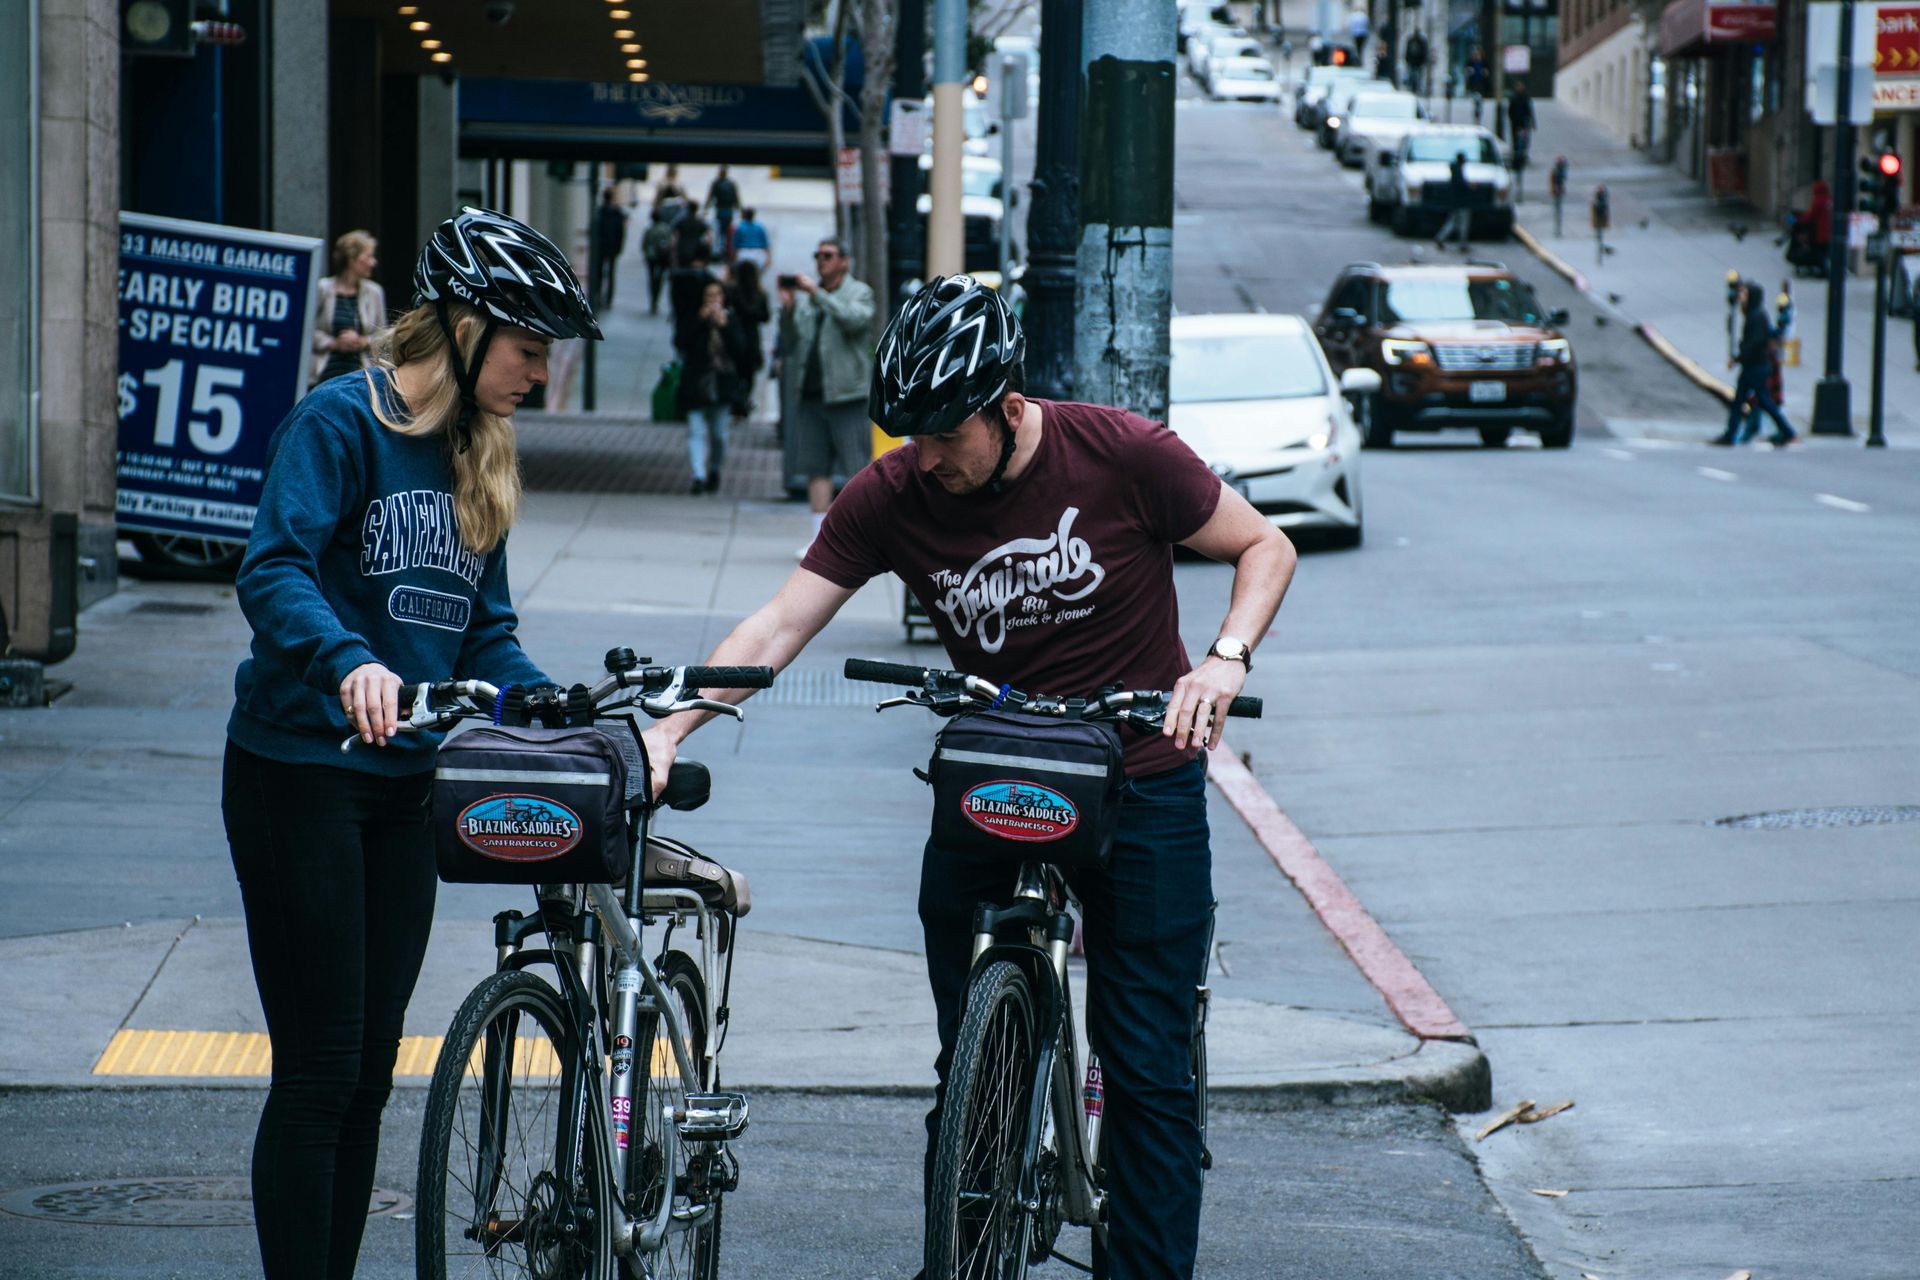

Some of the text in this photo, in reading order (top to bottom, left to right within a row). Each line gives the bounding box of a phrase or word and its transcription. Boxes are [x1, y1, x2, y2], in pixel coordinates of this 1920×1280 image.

[151, 237, 218, 266] MASON
[223, 247, 296, 275] GARAGE
[212, 281, 289, 322] BIRD
[360, 490, 411, 577] SAN
[928, 569, 962, 591] The
[934, 506, 1106, 654] Originals
[398, 594, 463, 623] CALIFORNIA
[1021, 595, 1049, 615] By
[1006, 614, 1038, 631] Jack
[612, 1098, 631, 1114] 39
